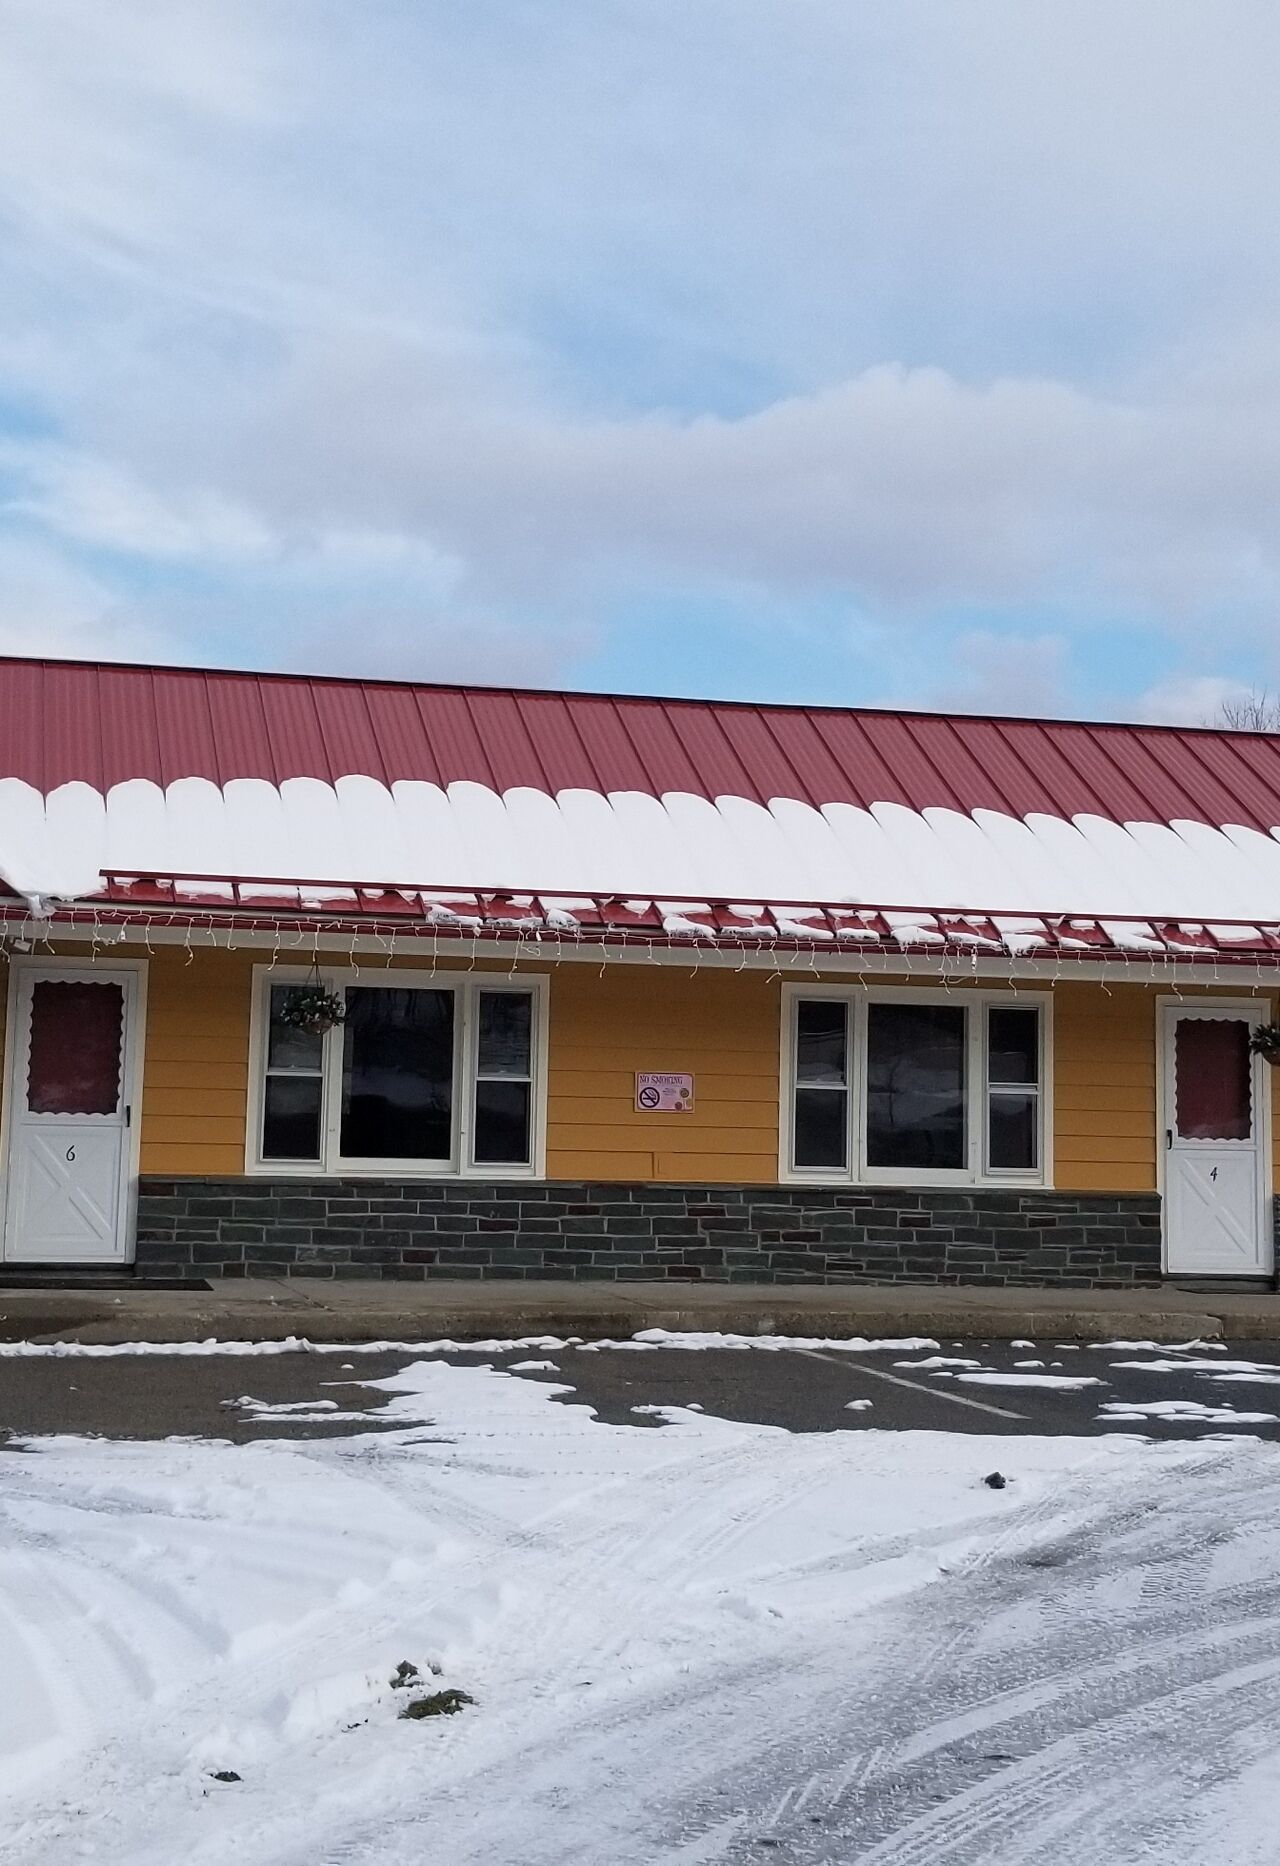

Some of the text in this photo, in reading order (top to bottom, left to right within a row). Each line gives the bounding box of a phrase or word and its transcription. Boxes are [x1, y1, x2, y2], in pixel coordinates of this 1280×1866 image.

[639, 1075, 683, 1085] NO SMOKING
[65, 1144, 76, 1162] 6
[1209, 1166, 1219, 1182] 4
